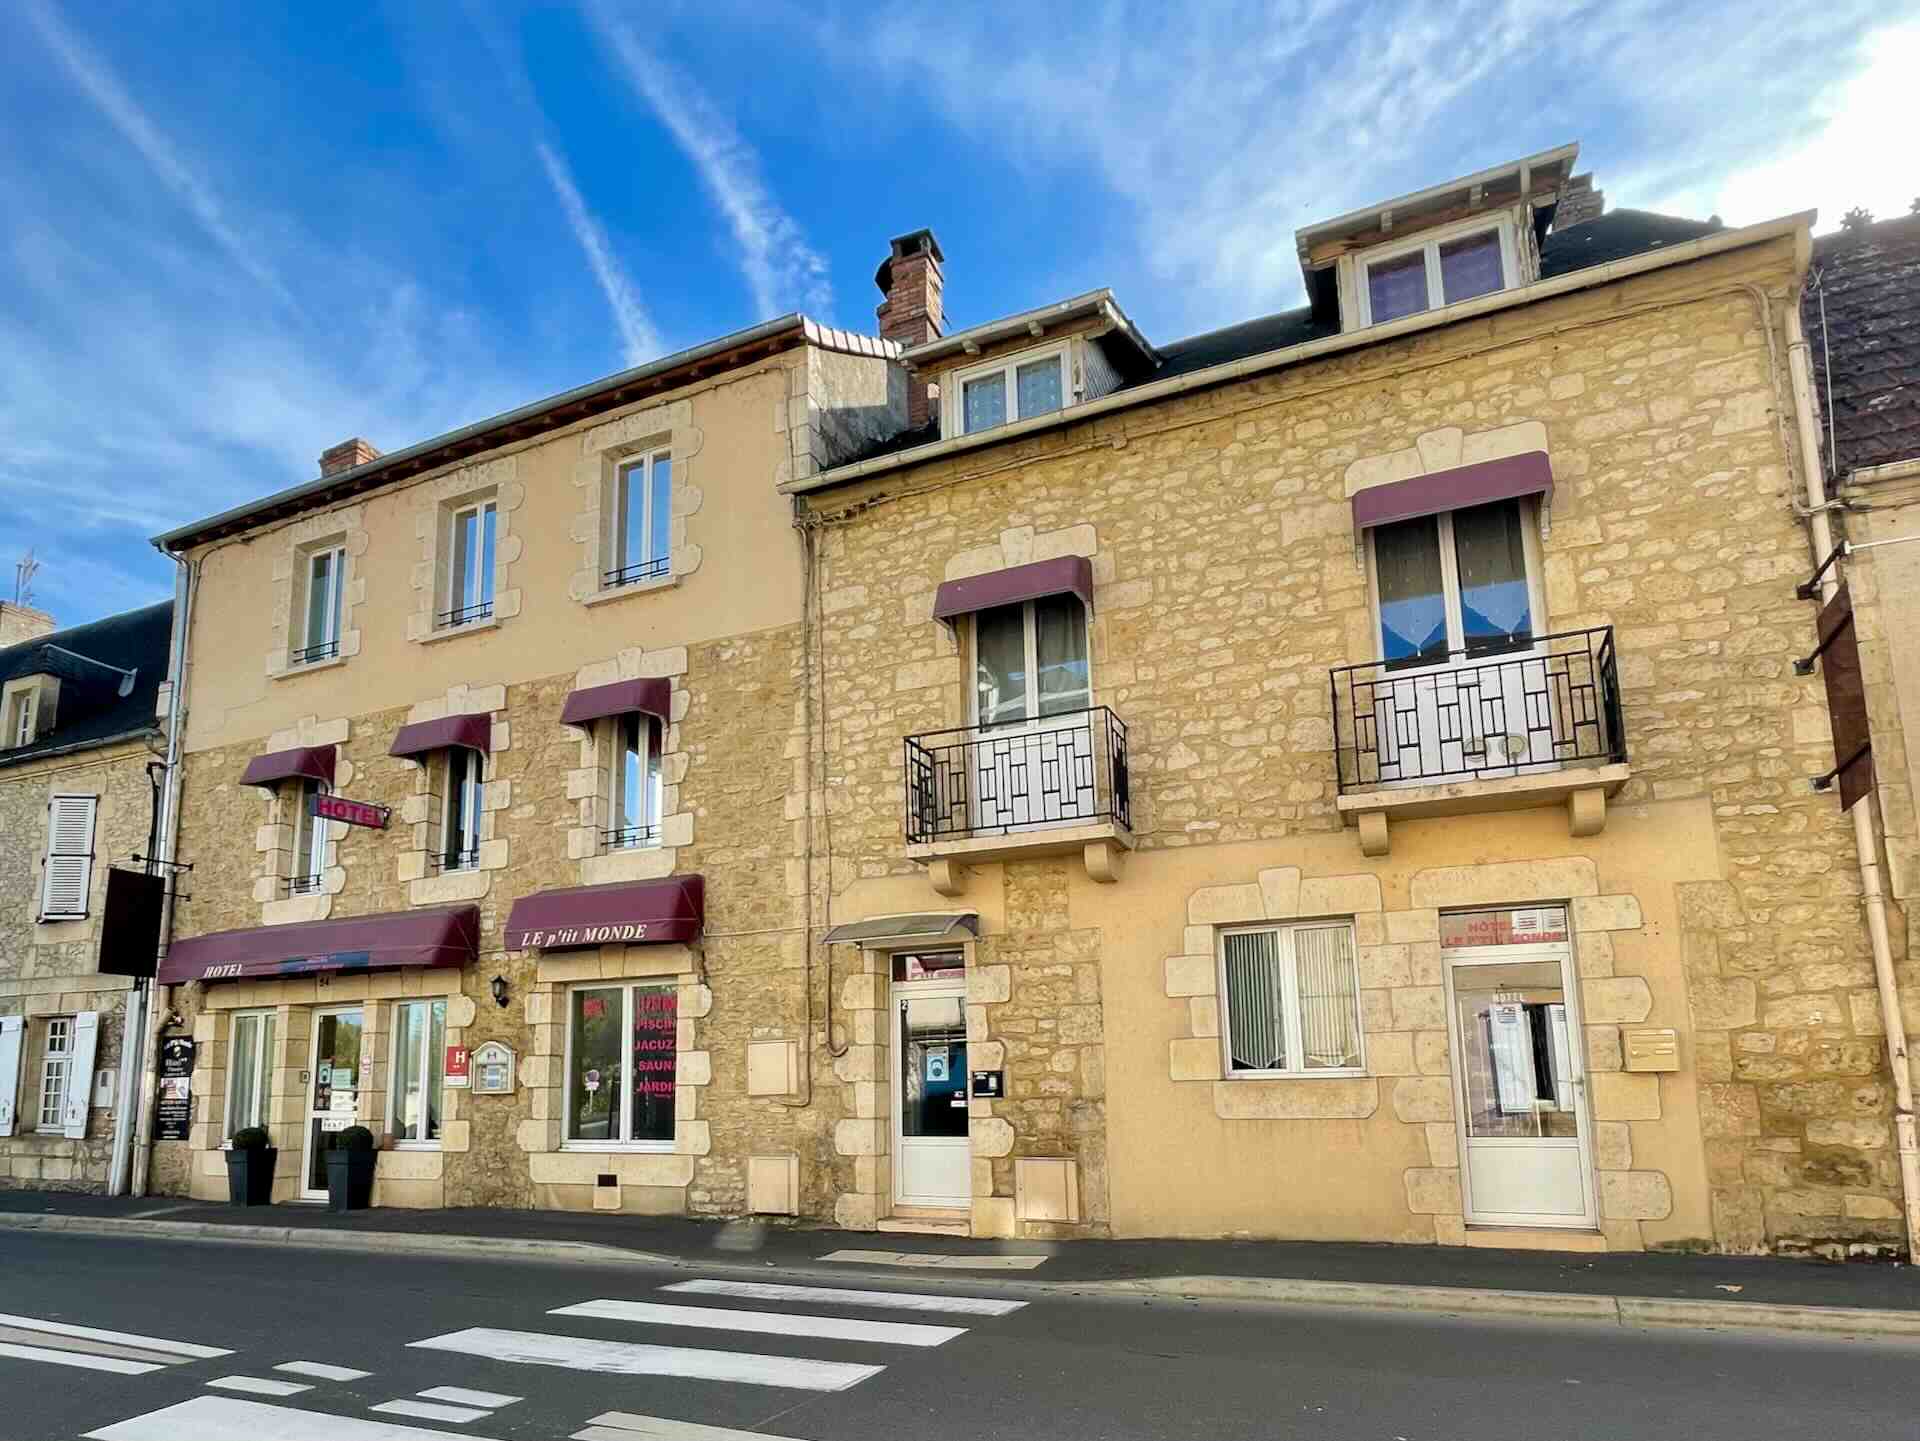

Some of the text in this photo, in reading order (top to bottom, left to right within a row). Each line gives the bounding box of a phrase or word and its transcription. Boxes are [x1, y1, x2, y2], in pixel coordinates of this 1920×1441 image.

[319, 798, 384, 827] HOTEL
[521, 924, 647, 947] LE p'tit MONDE
[203, 963, 243, 978] HOTEL
[455, 1051, 465, 1063] H
